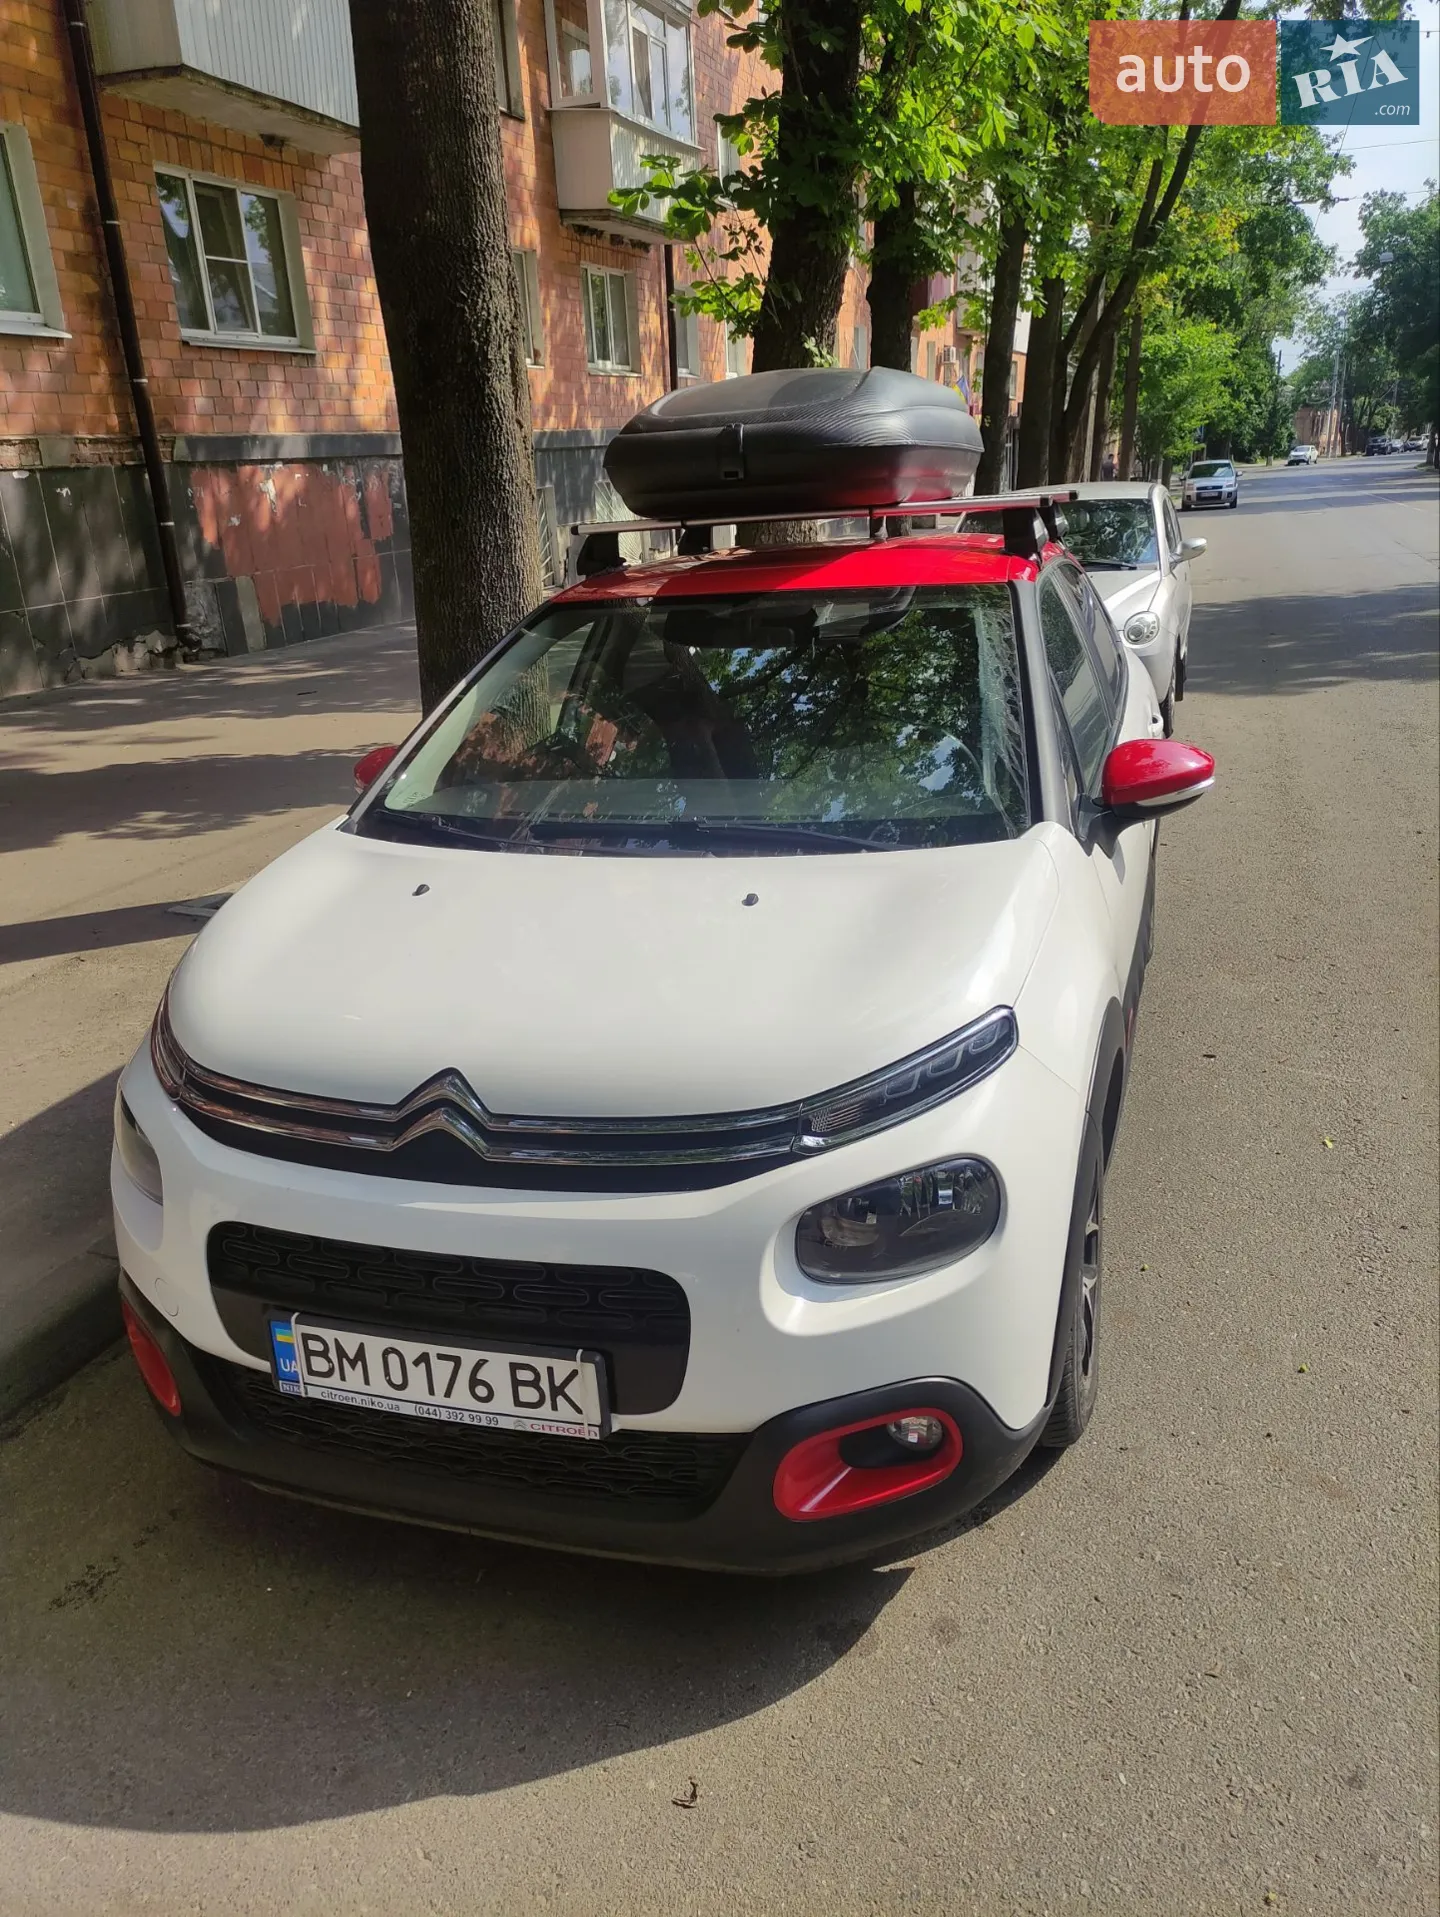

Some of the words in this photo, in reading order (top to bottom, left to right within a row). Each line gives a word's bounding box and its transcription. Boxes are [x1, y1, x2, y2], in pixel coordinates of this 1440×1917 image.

[280, 1357, 299, 1373] UA
[301, 1332, 371, 1386] BM
[381, 1346, 495, 1404] 0176
[509, 1361, 584, 1415] BK
[320, 1389, 401, 1412] citroen.niko.ua
[414, 1404, 442, 1419] (044)
[445, 1409, 465, 1421] 392
[468, 1413, 482, 1424] 99
[485, 1415, 499, 1426] 99
